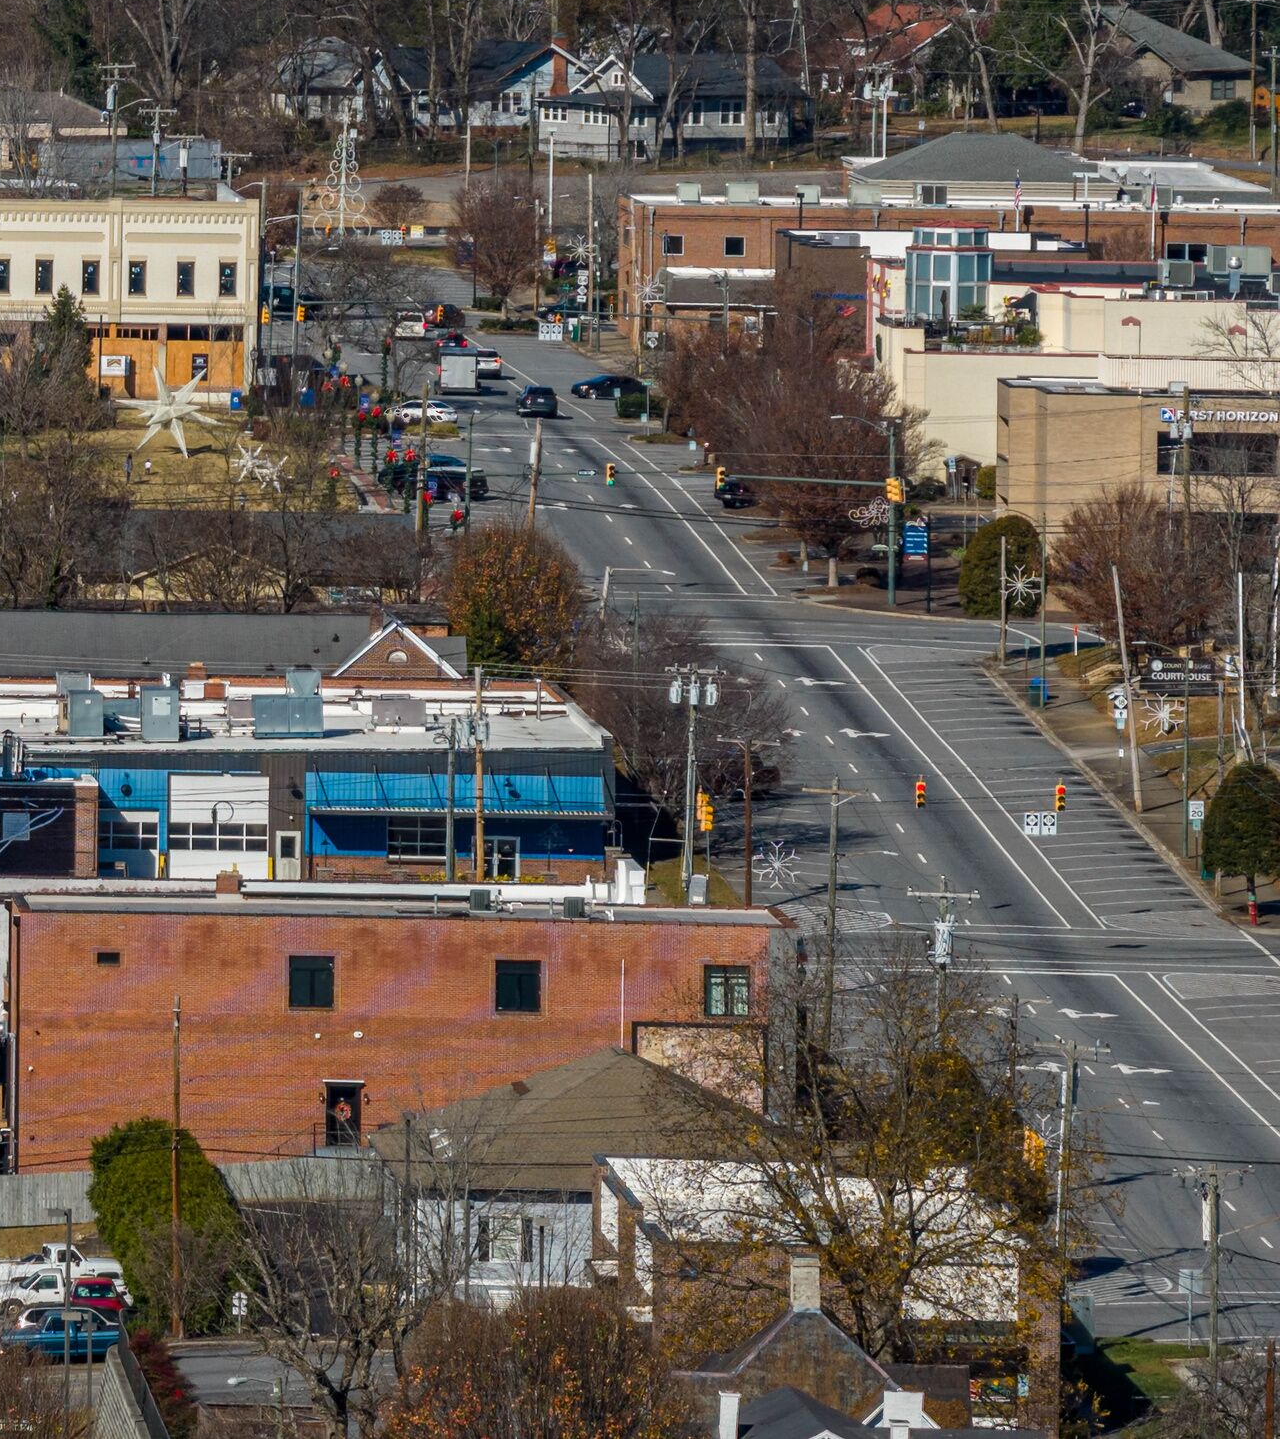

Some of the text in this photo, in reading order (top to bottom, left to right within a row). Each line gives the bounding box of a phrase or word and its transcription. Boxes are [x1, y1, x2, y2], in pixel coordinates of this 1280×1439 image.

[1177, 410, 1279, 422] FRST HORIZON
[1151, 671, 1212, 681] COURTHOUSE
[1191, 810, 1203, 818] 20
